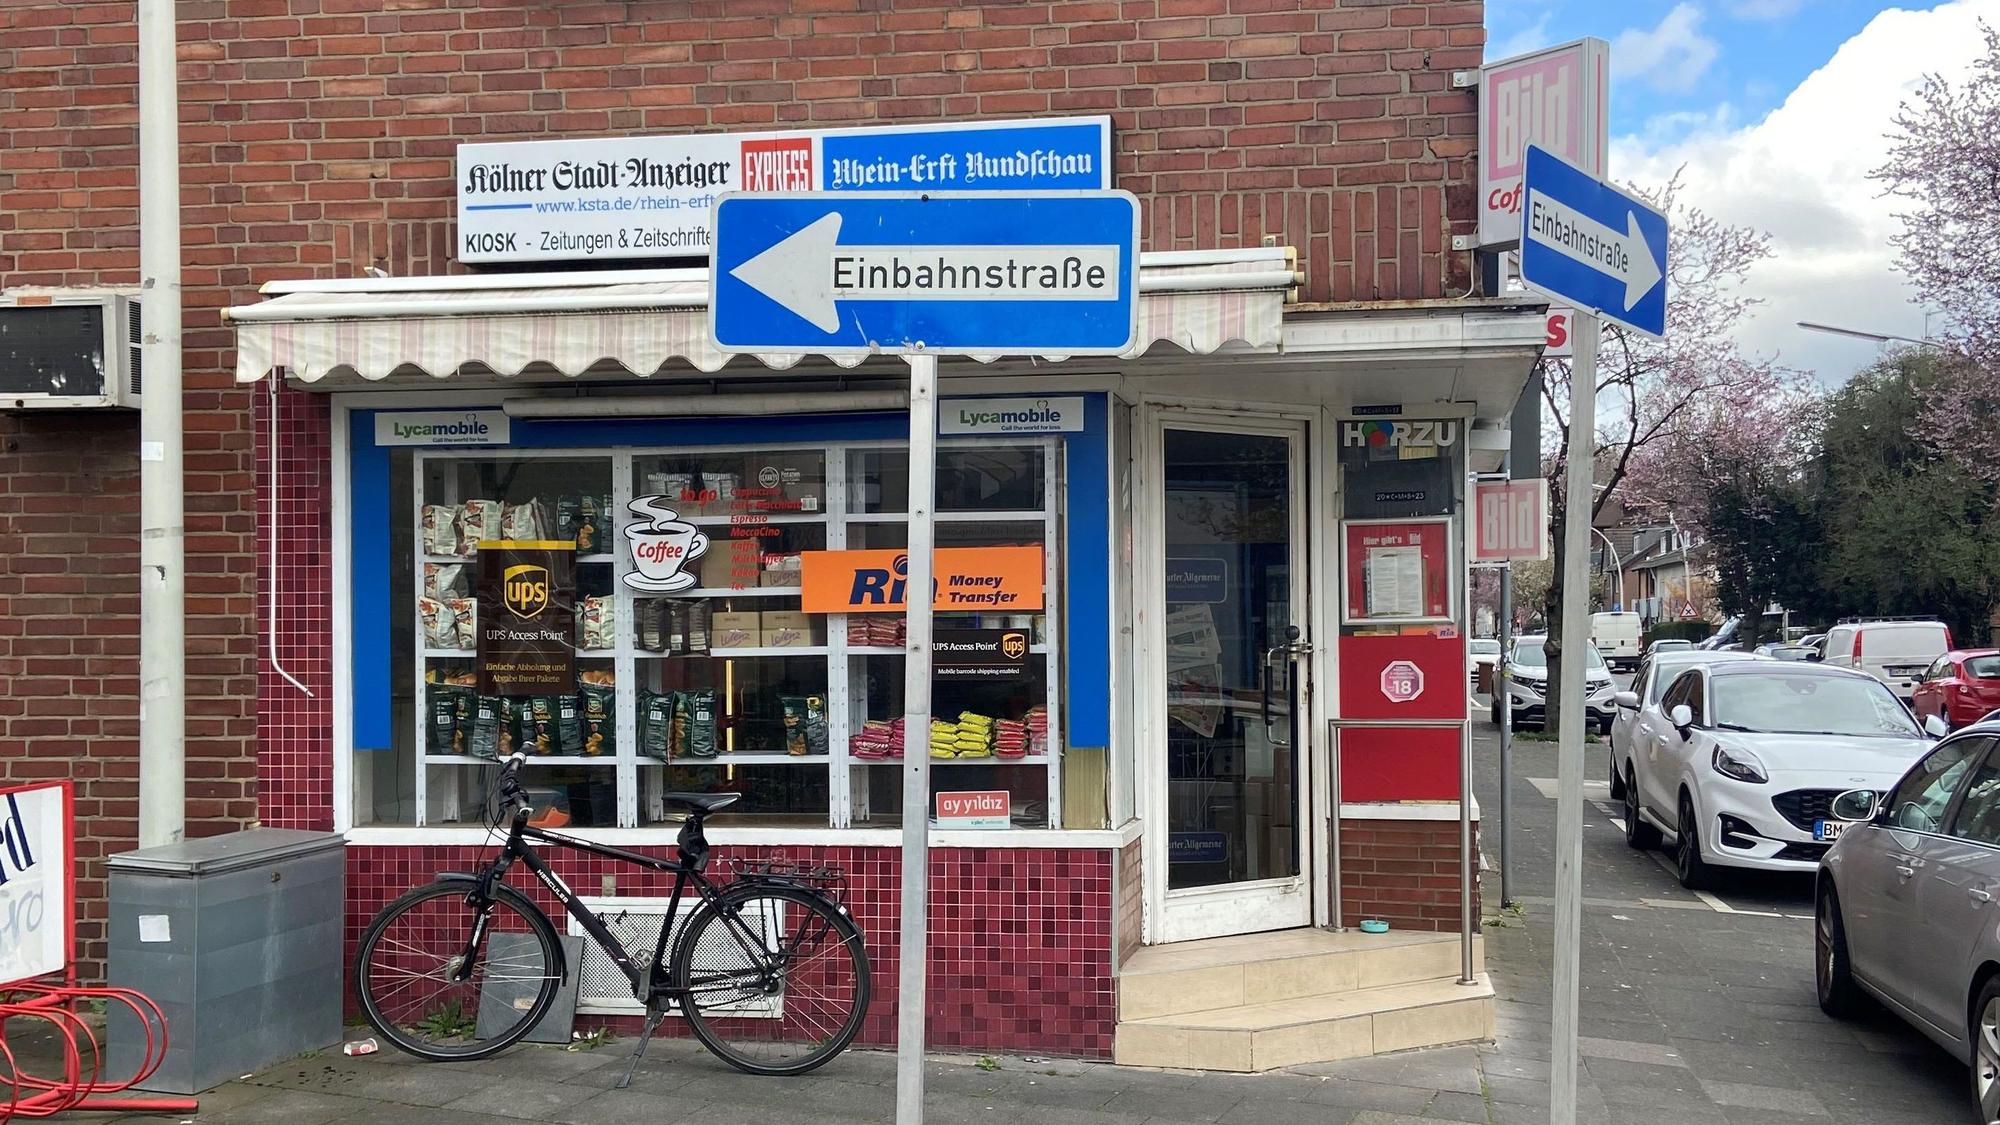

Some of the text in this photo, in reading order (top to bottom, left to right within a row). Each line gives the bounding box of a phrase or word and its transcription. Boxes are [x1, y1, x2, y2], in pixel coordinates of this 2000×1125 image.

[1497, 64, 1568, 168] Bild
[465, 156, 731, 194] Kölner Stadt-Anzeiger
[745, 149, 809, 191] EXPRESS
[831, 148, 1093, 189] Rhein-Erft Rundschau
[535, 195, 715, 215] www.ksta.de/rhein-erft
[465, 232, 517, 254] KIOSK
[540, 229, 613, 254] Zeitungen
[618, 229, 629, 248] &
[633, 226, 711, 249] Zeitschrifte
[1531, 200, 1629, 274] Einbahnstraße
[833, 255, 1105, 290] Einbahnstraße
[960, 408, 1061, 427] Lycamobile
[394, 420, 488, 438] Lycamobile
[680, 488, 717, 507] to go
[730, 514, 768, 525] Espresso
[1482, 490, 1534, 549] Bild
[637, 541, 683, 563] Coffee
[949, 575, 1003, 588] Money
[507, 581, 546, 610] ups
[949, 592, 1018, 606] Transfer
[486, 629, 565, 640] UPS Access Point
[932, 641, 997, 651] UPS Access Point
[1005, 641, 1024, 655] ups
[485, 663, 566, 672] Einfache Abholung und
[977, 668, 999, 676] shipping
[492, 674, 518, 683] Abgabe
[537, 675, 561, 683] Pakete
[1392, 680, 1412, 695] 18
[943, 795, 1003, 815] ay yıldız
[1823, 823, 1843, 836] BM
[537, 868, 569, 904] HERCULES
